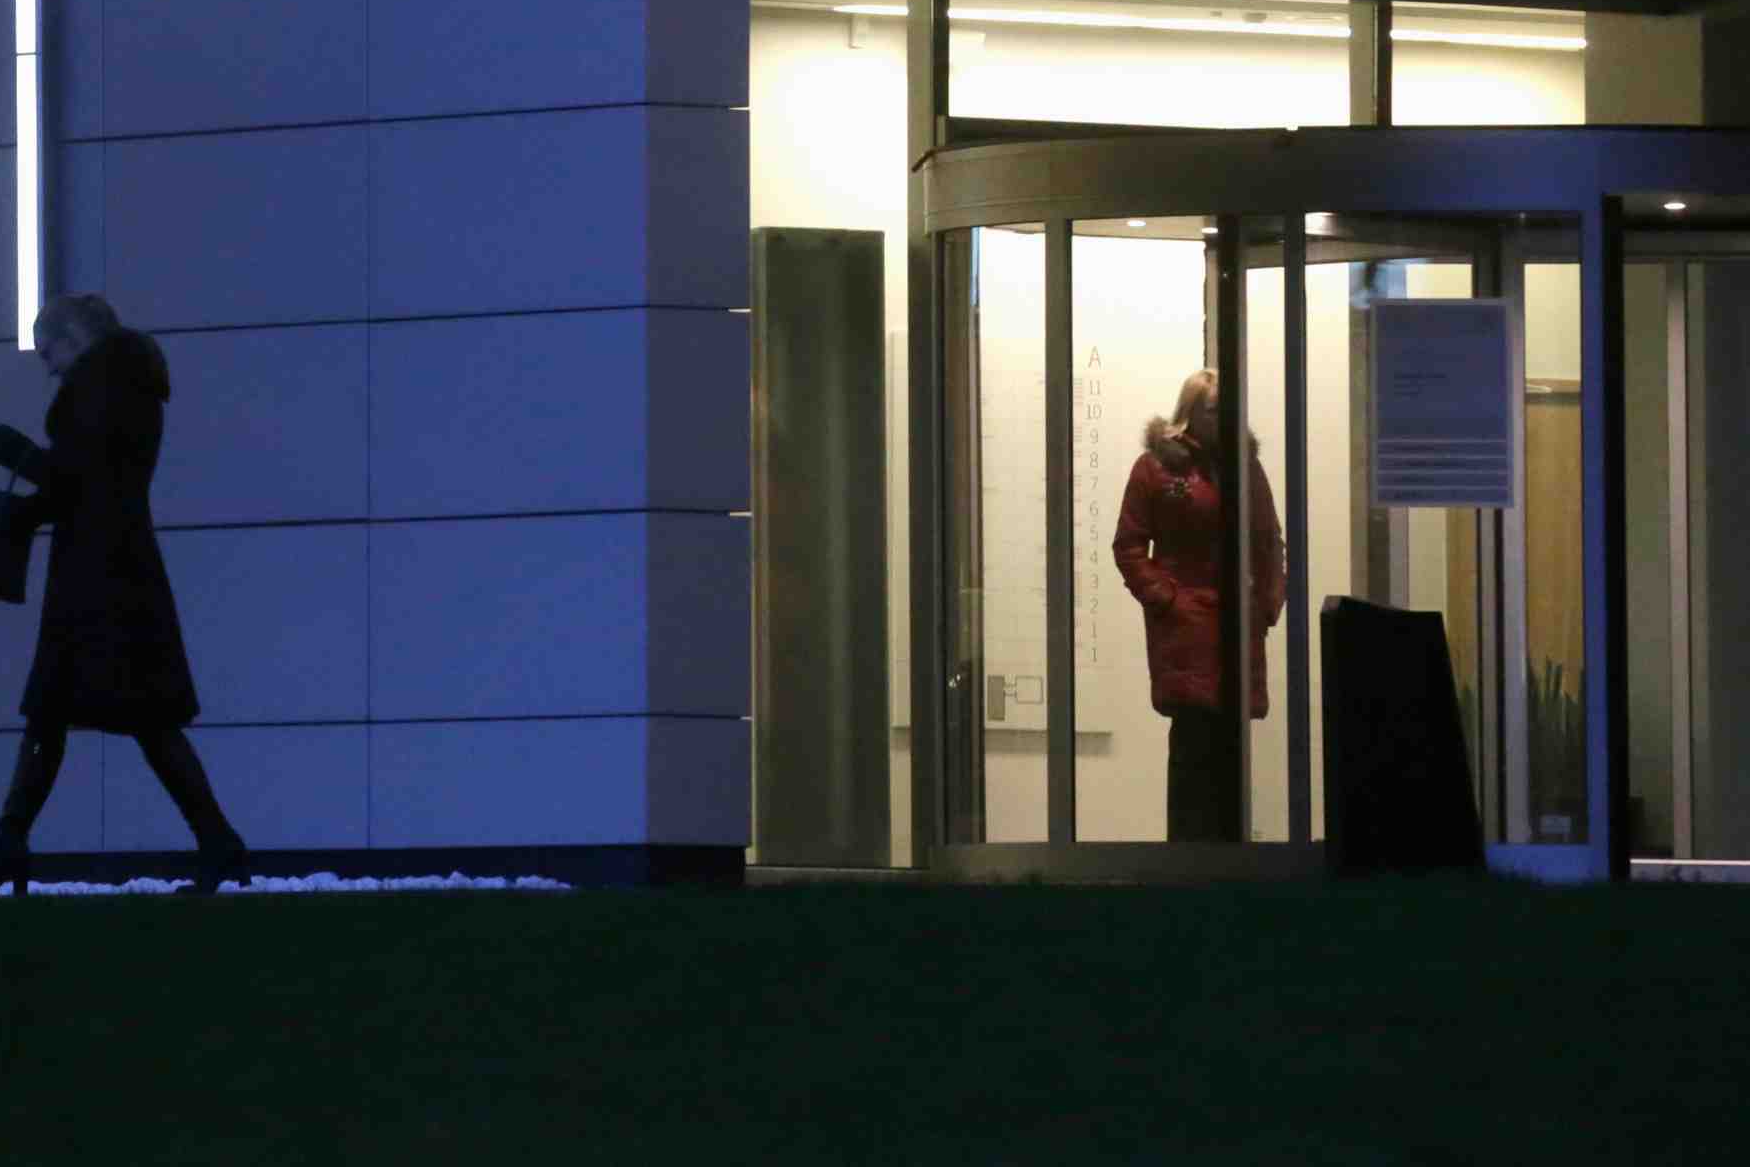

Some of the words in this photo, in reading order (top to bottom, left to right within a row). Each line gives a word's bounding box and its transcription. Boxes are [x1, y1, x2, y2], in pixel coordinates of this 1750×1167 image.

[1087, 345, 1102, 370] A
[1086, 402, 1103, 421] 10
[1089, 427, 1099, 445] 9
[1089, 451, 1099, 469] 8
[1089, 475, 1099, 491] 7
[1089, 500, 1099, 516] 6
[1089, 524, 1099, 541] 5
[1089, 549, 1099, 565] 4
[1090, 573, 1099, 590] 3
[1089, 597, 1099, 614] 2
